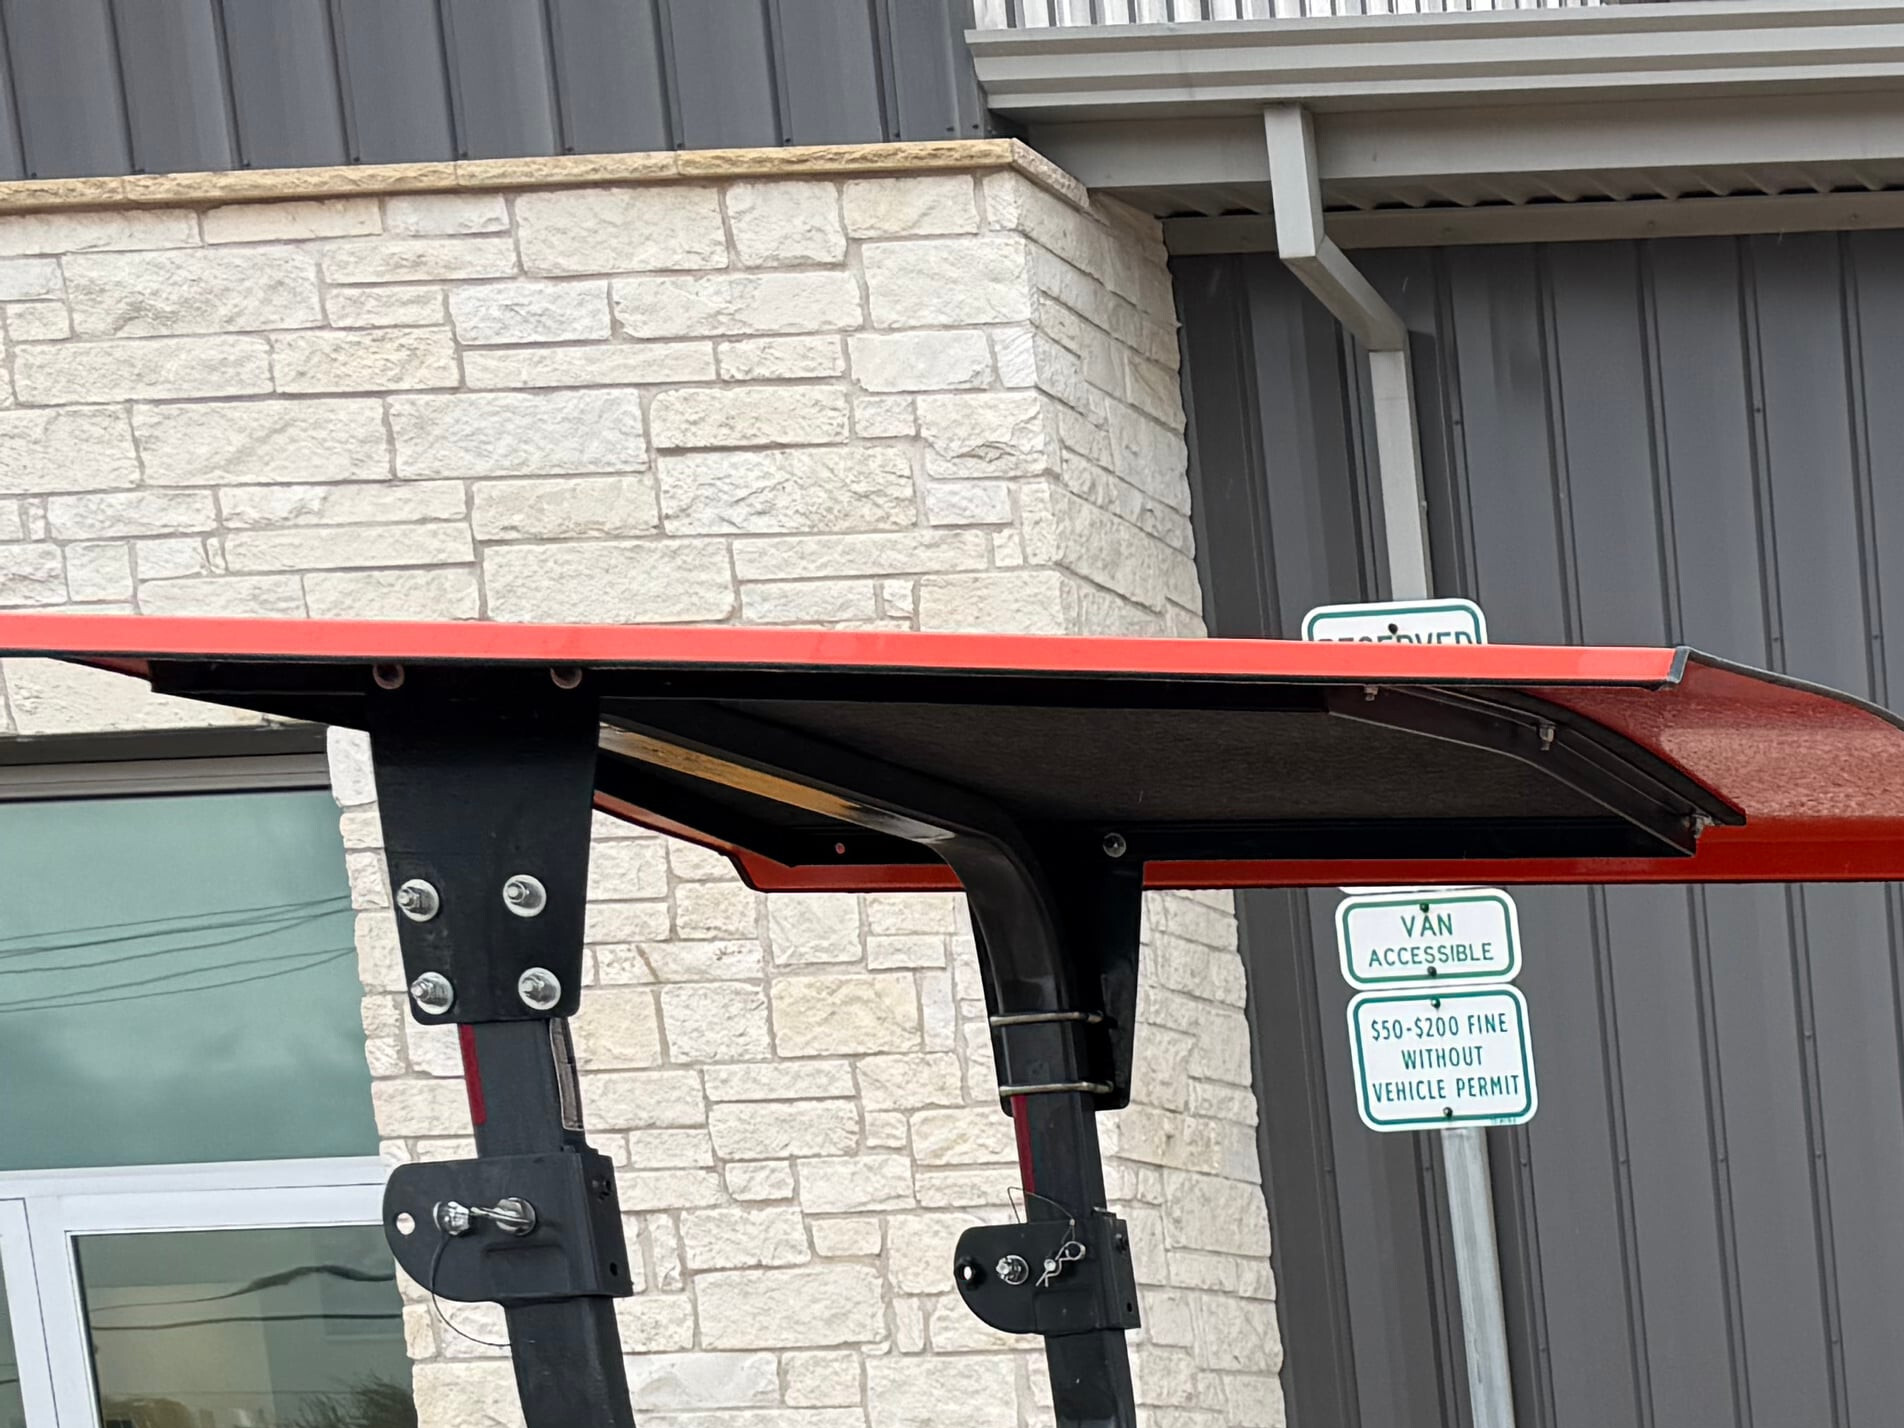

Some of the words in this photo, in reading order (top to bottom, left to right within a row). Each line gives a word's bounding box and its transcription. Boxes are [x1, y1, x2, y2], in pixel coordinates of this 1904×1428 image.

[1400, 912, 1454, 938] VAN
[1368, 942, 1495, 968] ACCESSIBLE
[1371, 1015, 1460, 1042] $50-$200
[1467, 1012, 1509, 1036] FINE
[1401, 1045, 1484, 1071] WITHOUT
[1372, 1078, 1447, 1104] VEHICLE
[1456, 1074, 1520, 1099] PERMIT
